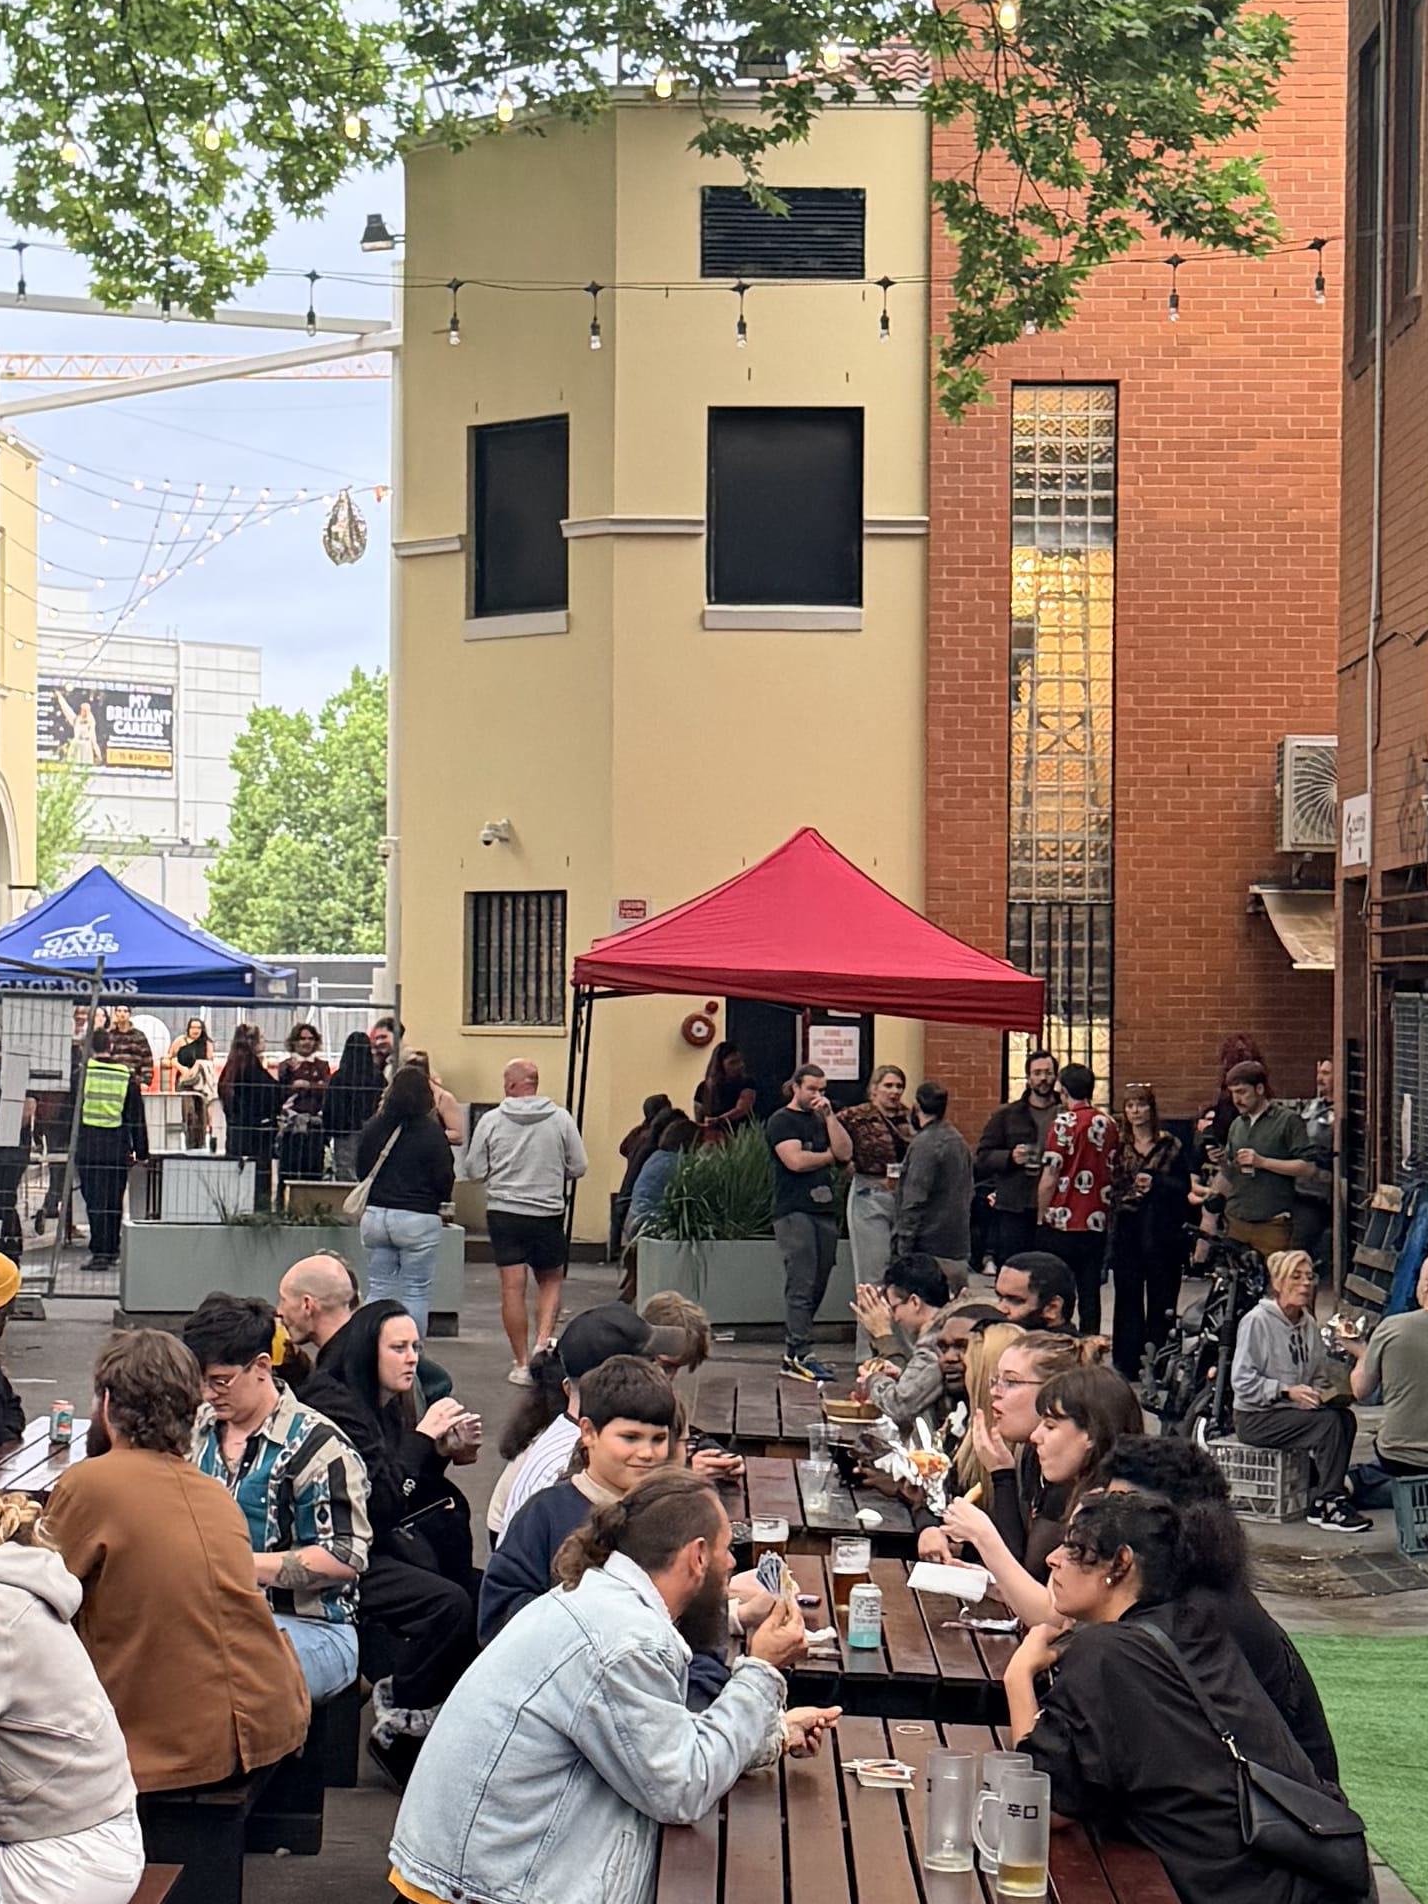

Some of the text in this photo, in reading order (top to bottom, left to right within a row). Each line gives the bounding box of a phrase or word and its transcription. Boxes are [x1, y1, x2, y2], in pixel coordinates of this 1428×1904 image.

[129, 694, 151, 708] MY
[106, 705, 172, 725] BRILLIANT
[113, 721, 163, 737] CAREER
